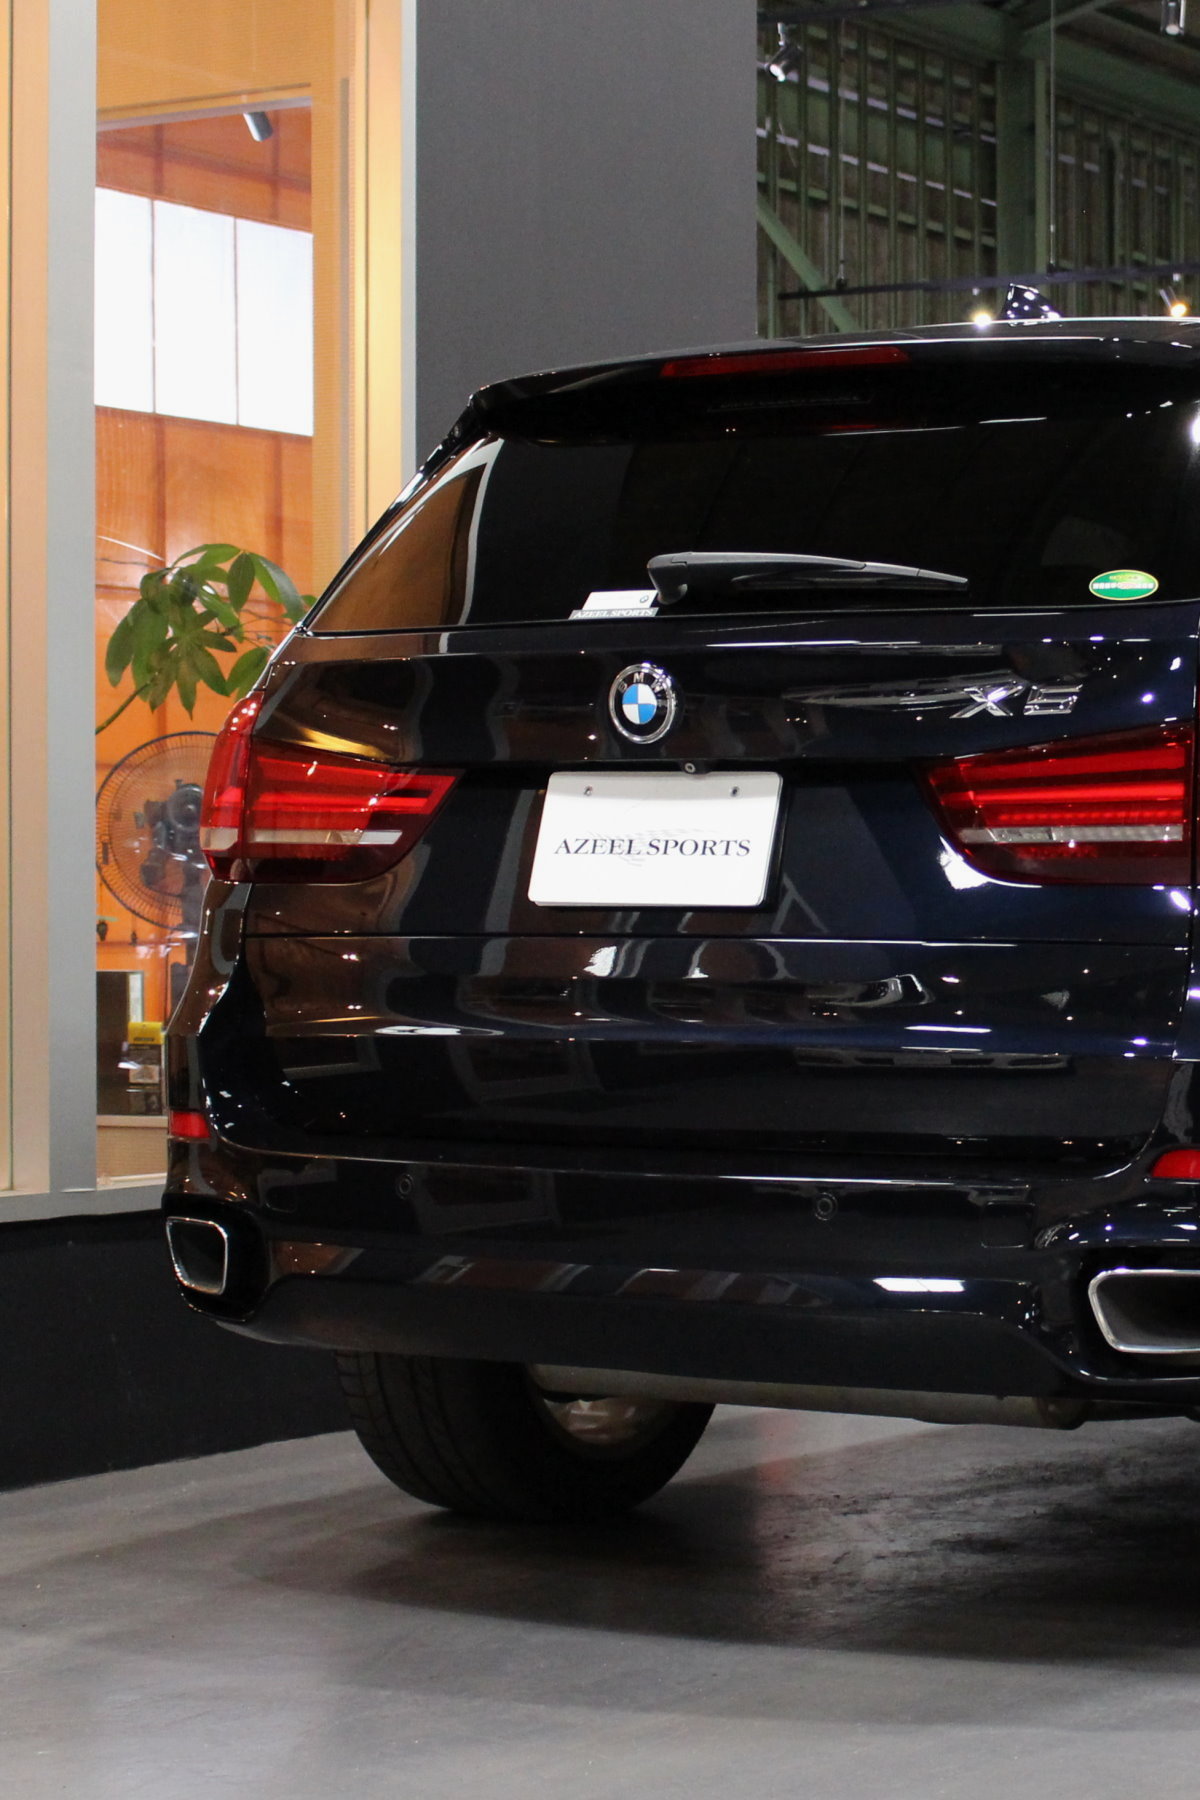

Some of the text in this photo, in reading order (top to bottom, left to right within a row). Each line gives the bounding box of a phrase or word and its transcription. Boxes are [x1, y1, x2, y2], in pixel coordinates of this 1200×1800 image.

[610, 608, 653, 617] SPORTS
[949, 684, 1083, 719] X5
[554, 838, 751, 856] AZEEL SPORTS
